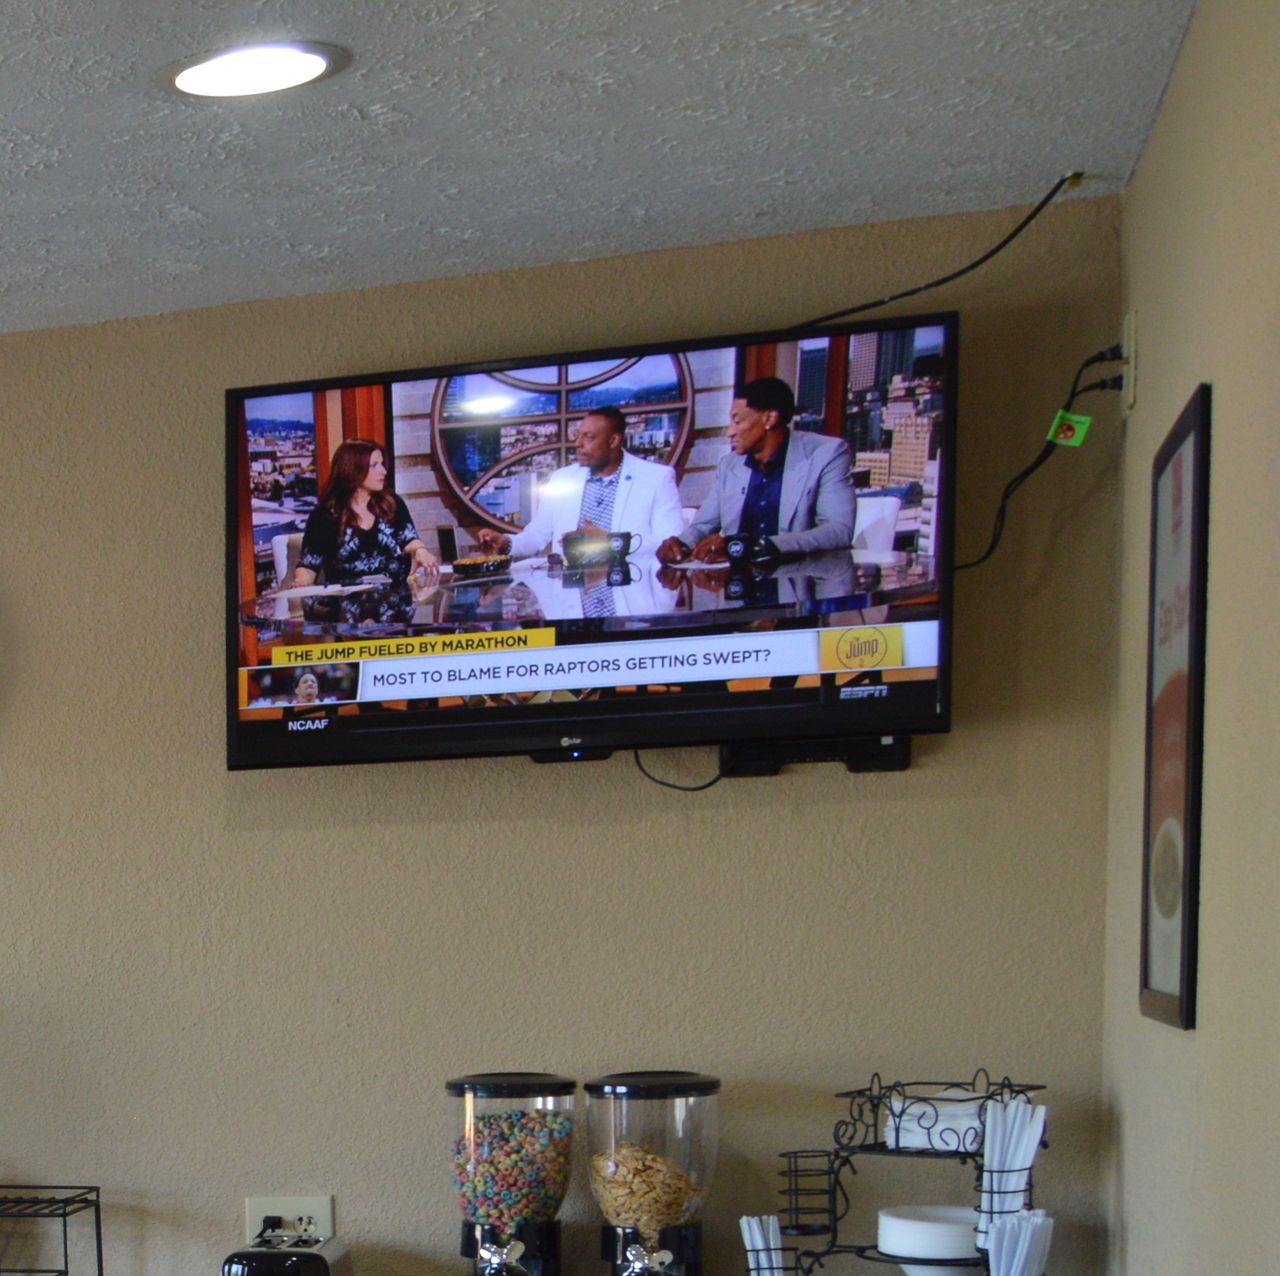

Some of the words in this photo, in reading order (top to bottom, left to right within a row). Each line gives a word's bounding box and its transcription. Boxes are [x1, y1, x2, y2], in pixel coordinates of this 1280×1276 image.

[285, 651, 313, 663] THE
[317, 647, 356, 661] JUMP
[359, 643, 415, 658] FUELED
[419, 641, 438, 653] BY
[442, 635, 528, 652] MARATHON
[846, 638, 879, 659] Jump
[372, 672, 417, 687] MOST
[422, 670, 443, 683] TO
[448, 666, 502, 682] BLAME
[506, 664, 539, 678] FOR
[544, 658, 621, 676] RAPTORS
[626, 653, 698, 671] GETTING
[703, 648, 771, 666] SWEPT?
[840, 685, 888, 699] ESPN
[288, 718, 329, 731] NCAAF
